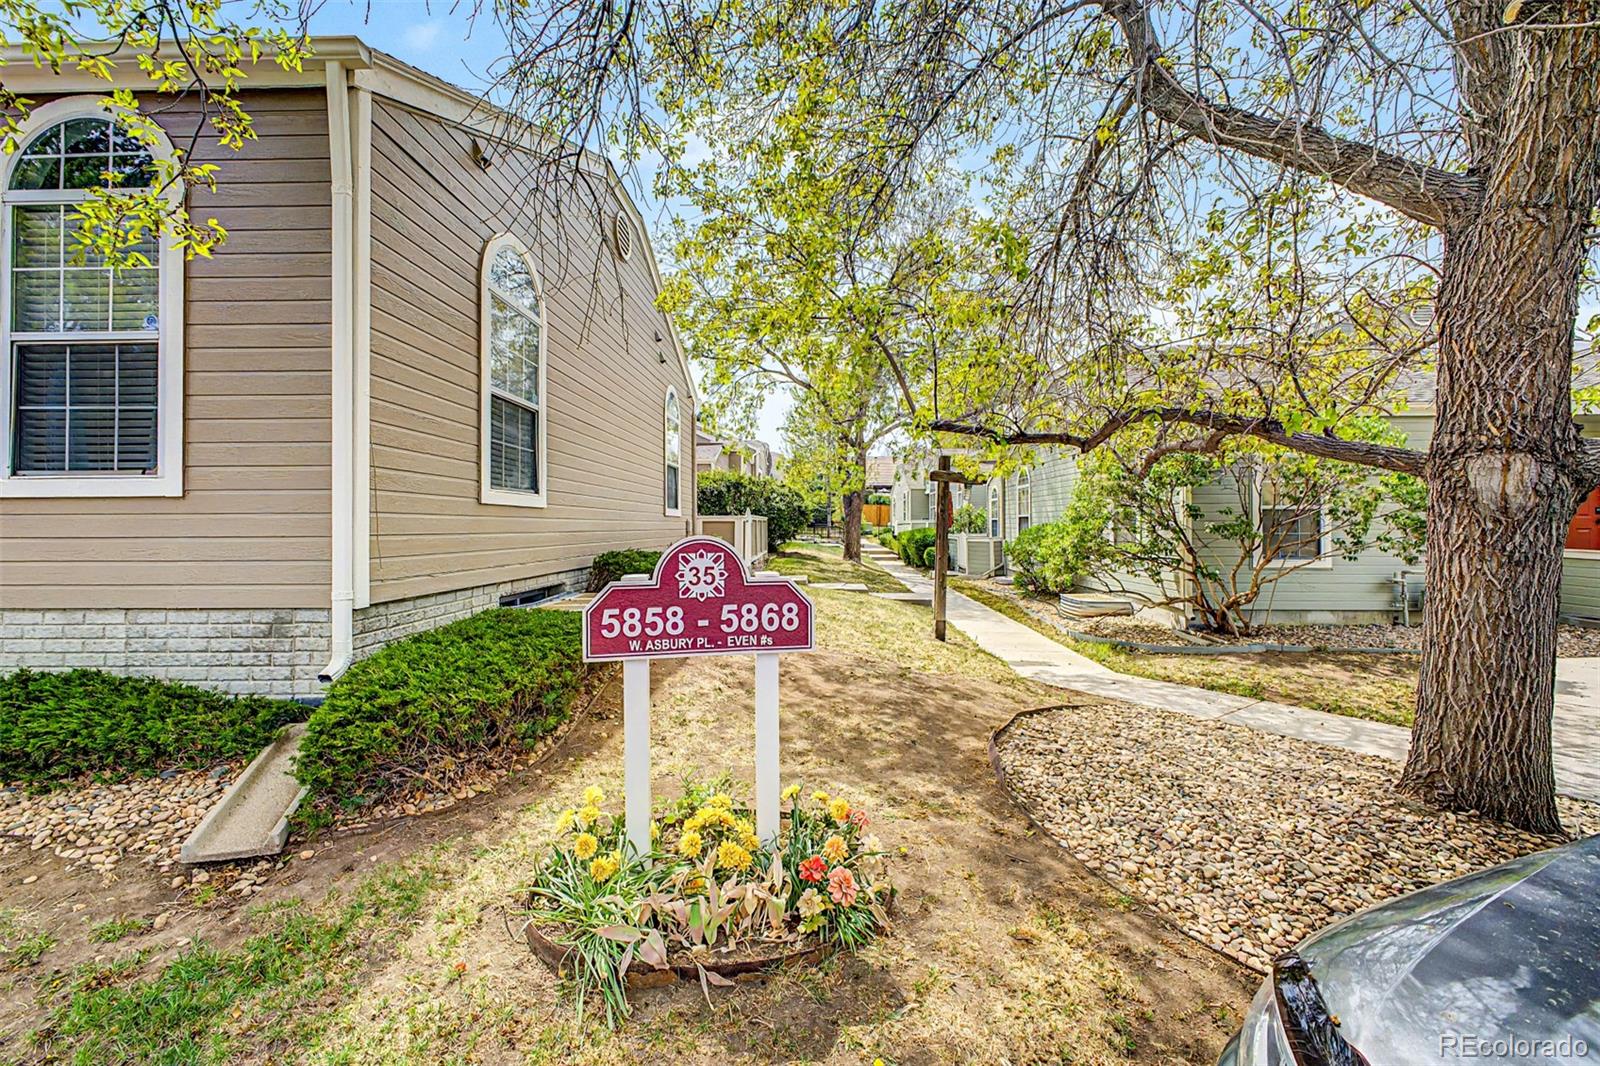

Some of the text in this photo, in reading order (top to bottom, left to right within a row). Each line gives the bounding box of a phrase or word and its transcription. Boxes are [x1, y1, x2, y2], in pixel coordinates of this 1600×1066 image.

[688, 566, 715, 585] 35
[600, 605, 685, 638] 5858
[720, 602, 799, 633] 5868
[628, 639, 643, 651] W.
[645, 637, 693, 651] ASBURY
[696, 637, 715, 649] PL.
[727, 635, 757, 647] EVEN
[760, 634, 773, 646] #s
